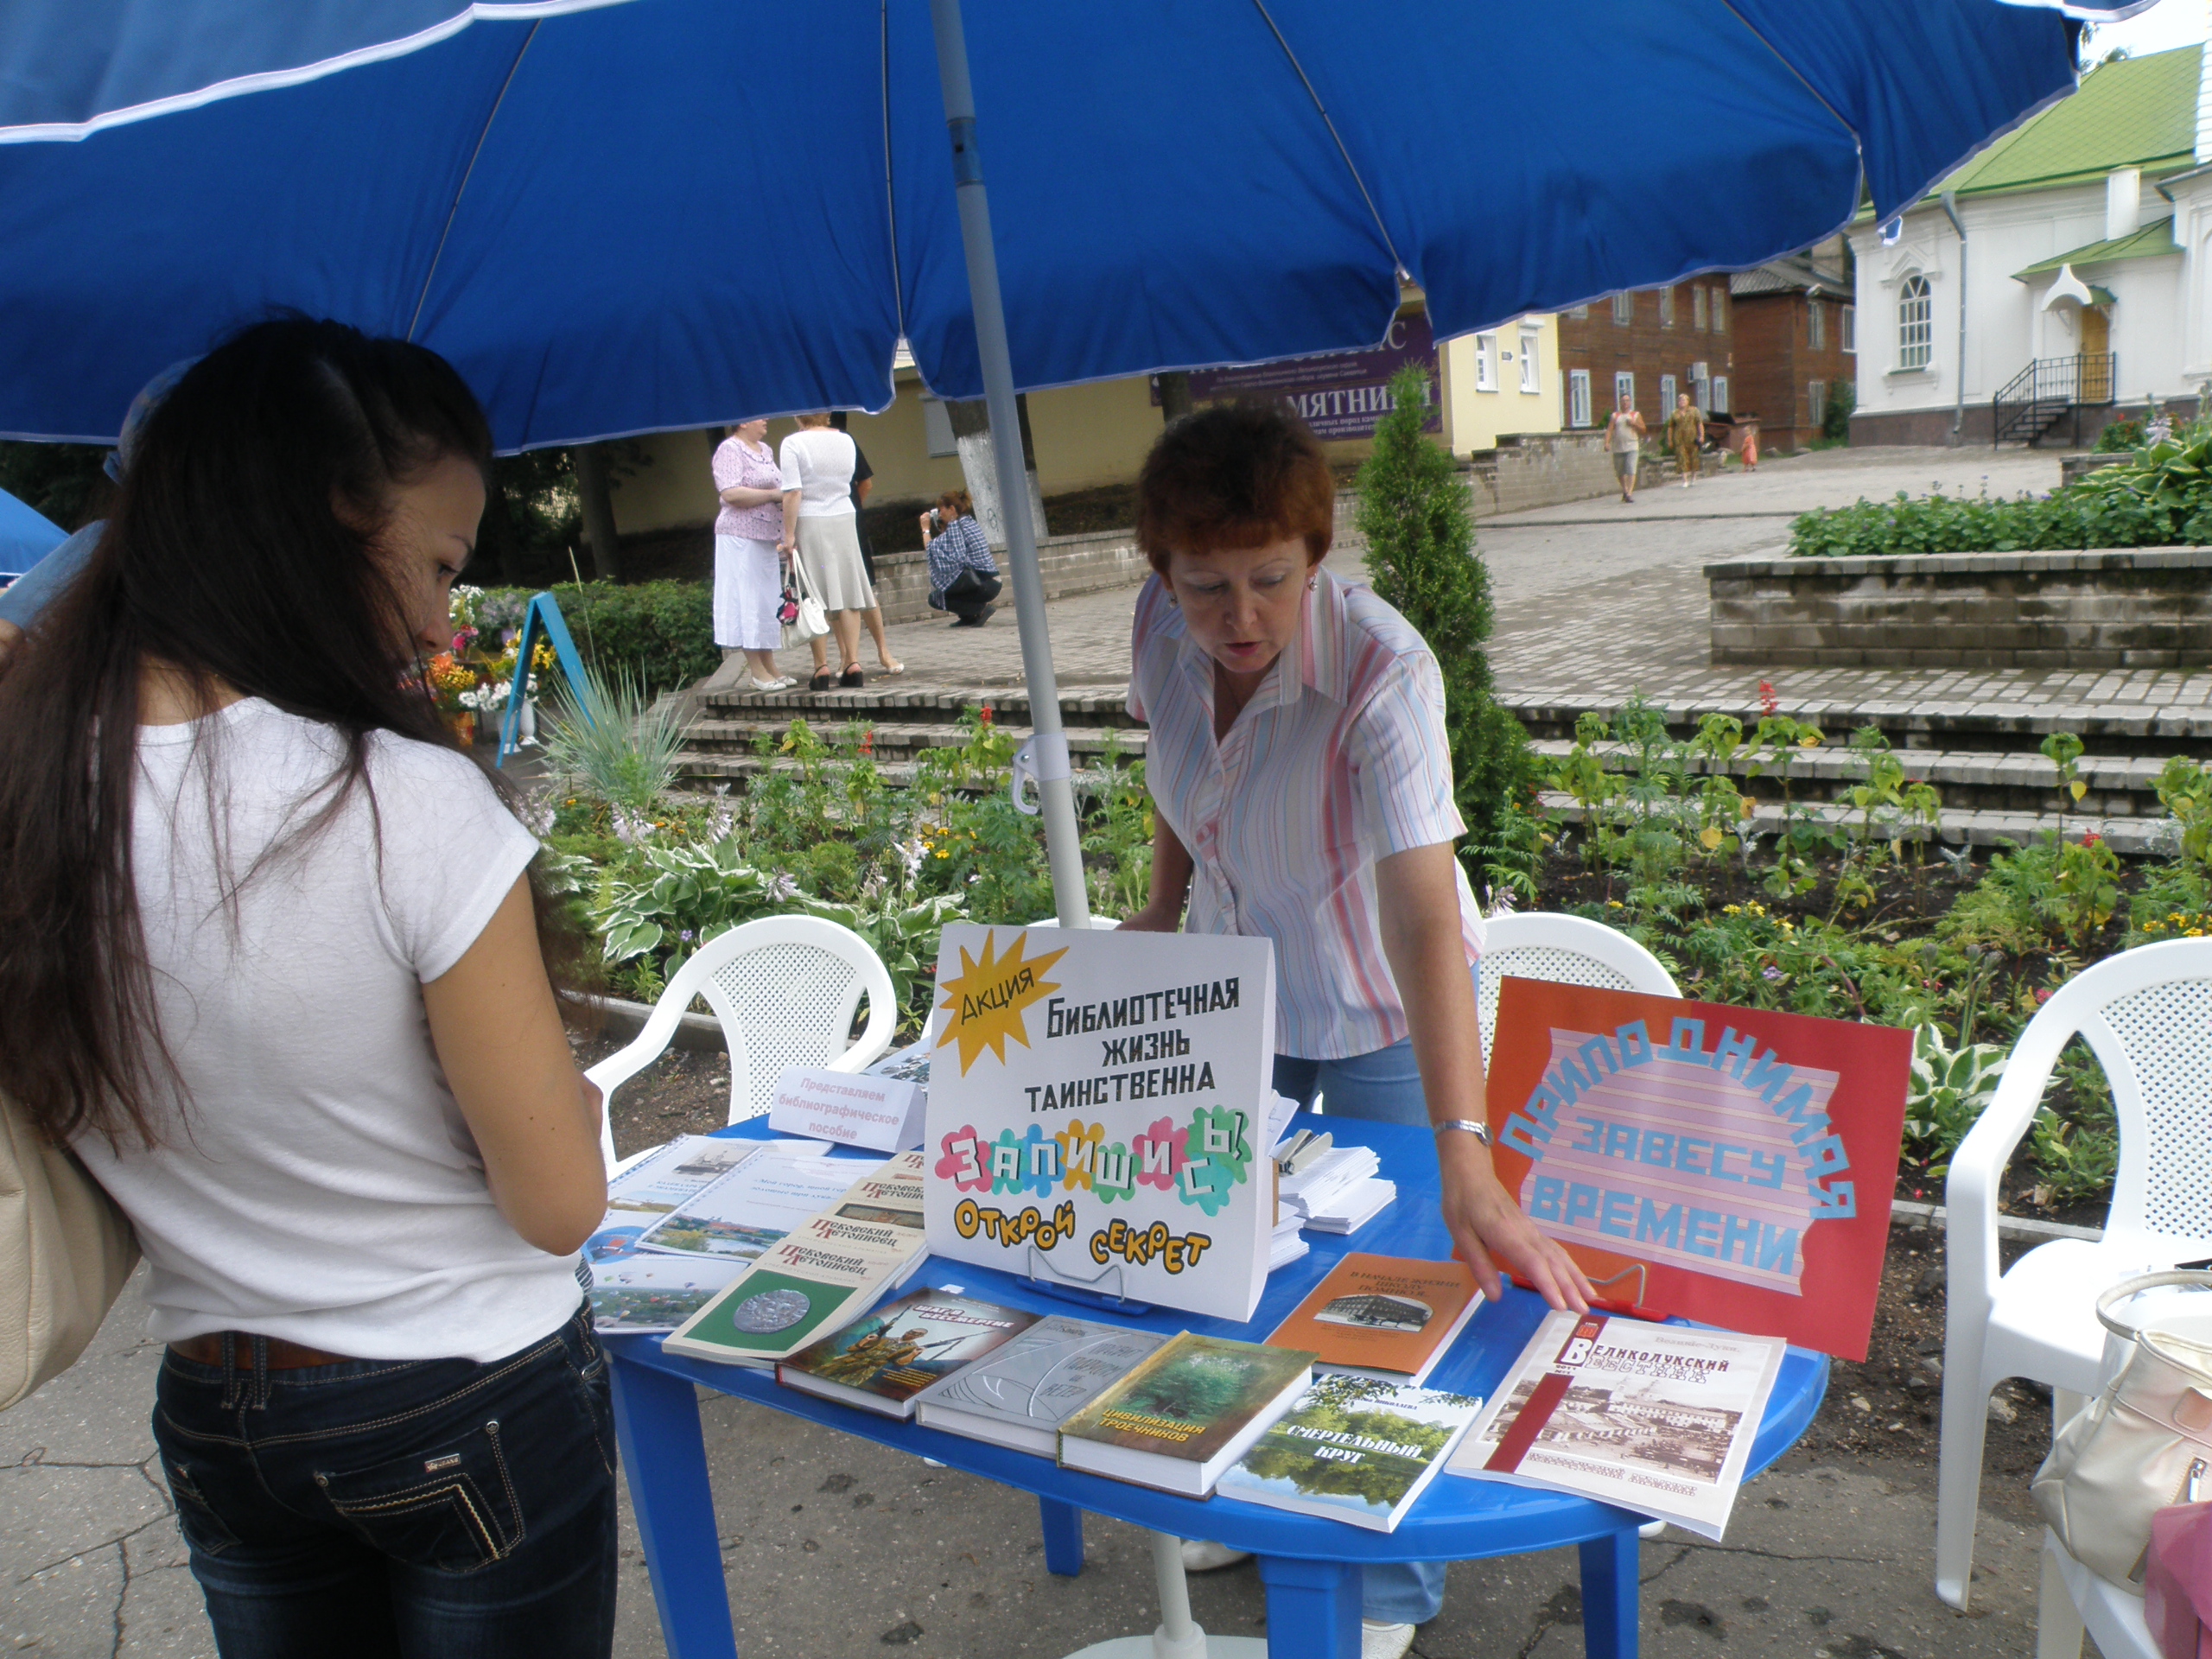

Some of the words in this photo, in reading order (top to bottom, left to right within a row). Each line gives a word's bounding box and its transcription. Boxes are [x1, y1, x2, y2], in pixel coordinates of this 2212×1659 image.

[1286, 381, 1432, 417] МЯТНИ
[960, 967, 1035, 1027] АКЦИЯ
[1046, 977, 1240, 1039] БИБЛИОТЕЧНАЯ
[1102, 1029, 1191, 1067] ЖИЗНЬ
[800, 1077, 887, 1103] Представляем
[1024, 1062, 1216, 1112] ТАИНСТВЕННА
[779, 1093, 900, 1126] библиографическое
[809, 1122, 858, 1140] пособие
[1570, 1116, 1786, 1190] ЗАВЕСУ
[860, 1182, 925, 1193] ПСКОВСК
[867, 1189, 925, 1199] ЛЕТОПИС
[810, 1218, 894, 1237] ПСКОВСКИЙ
[816, 1228, 899, 1247] ЛЕТОПИСЕЦ
[954, 1198, 1075, 1250] ОТКРОЙ
[1529, 1175, 1801, 1275] ВРЕМЕНИ
[778, 1244, 865, 1266] ПСКОВСКИЙ
[1089, 1217, 1211, 1274] СЕКРЕТ
[783, 1254, 868, 1275] ЛЕТОПИСЕЦ
[1585, 1352, 1710, 1384] ВЕСТНИК
[1099, 1418, 1190, 1442] ТРОЕЧНИКОВ
[1102, 1408, 1207, 1434] ЦИВИЛИЗАЦИЯ
[1287, 1425, 1423, 1459] СМЕРТЕЛЬНЫЙ
[1313, 1446, 1366, 1465] КРУГ
